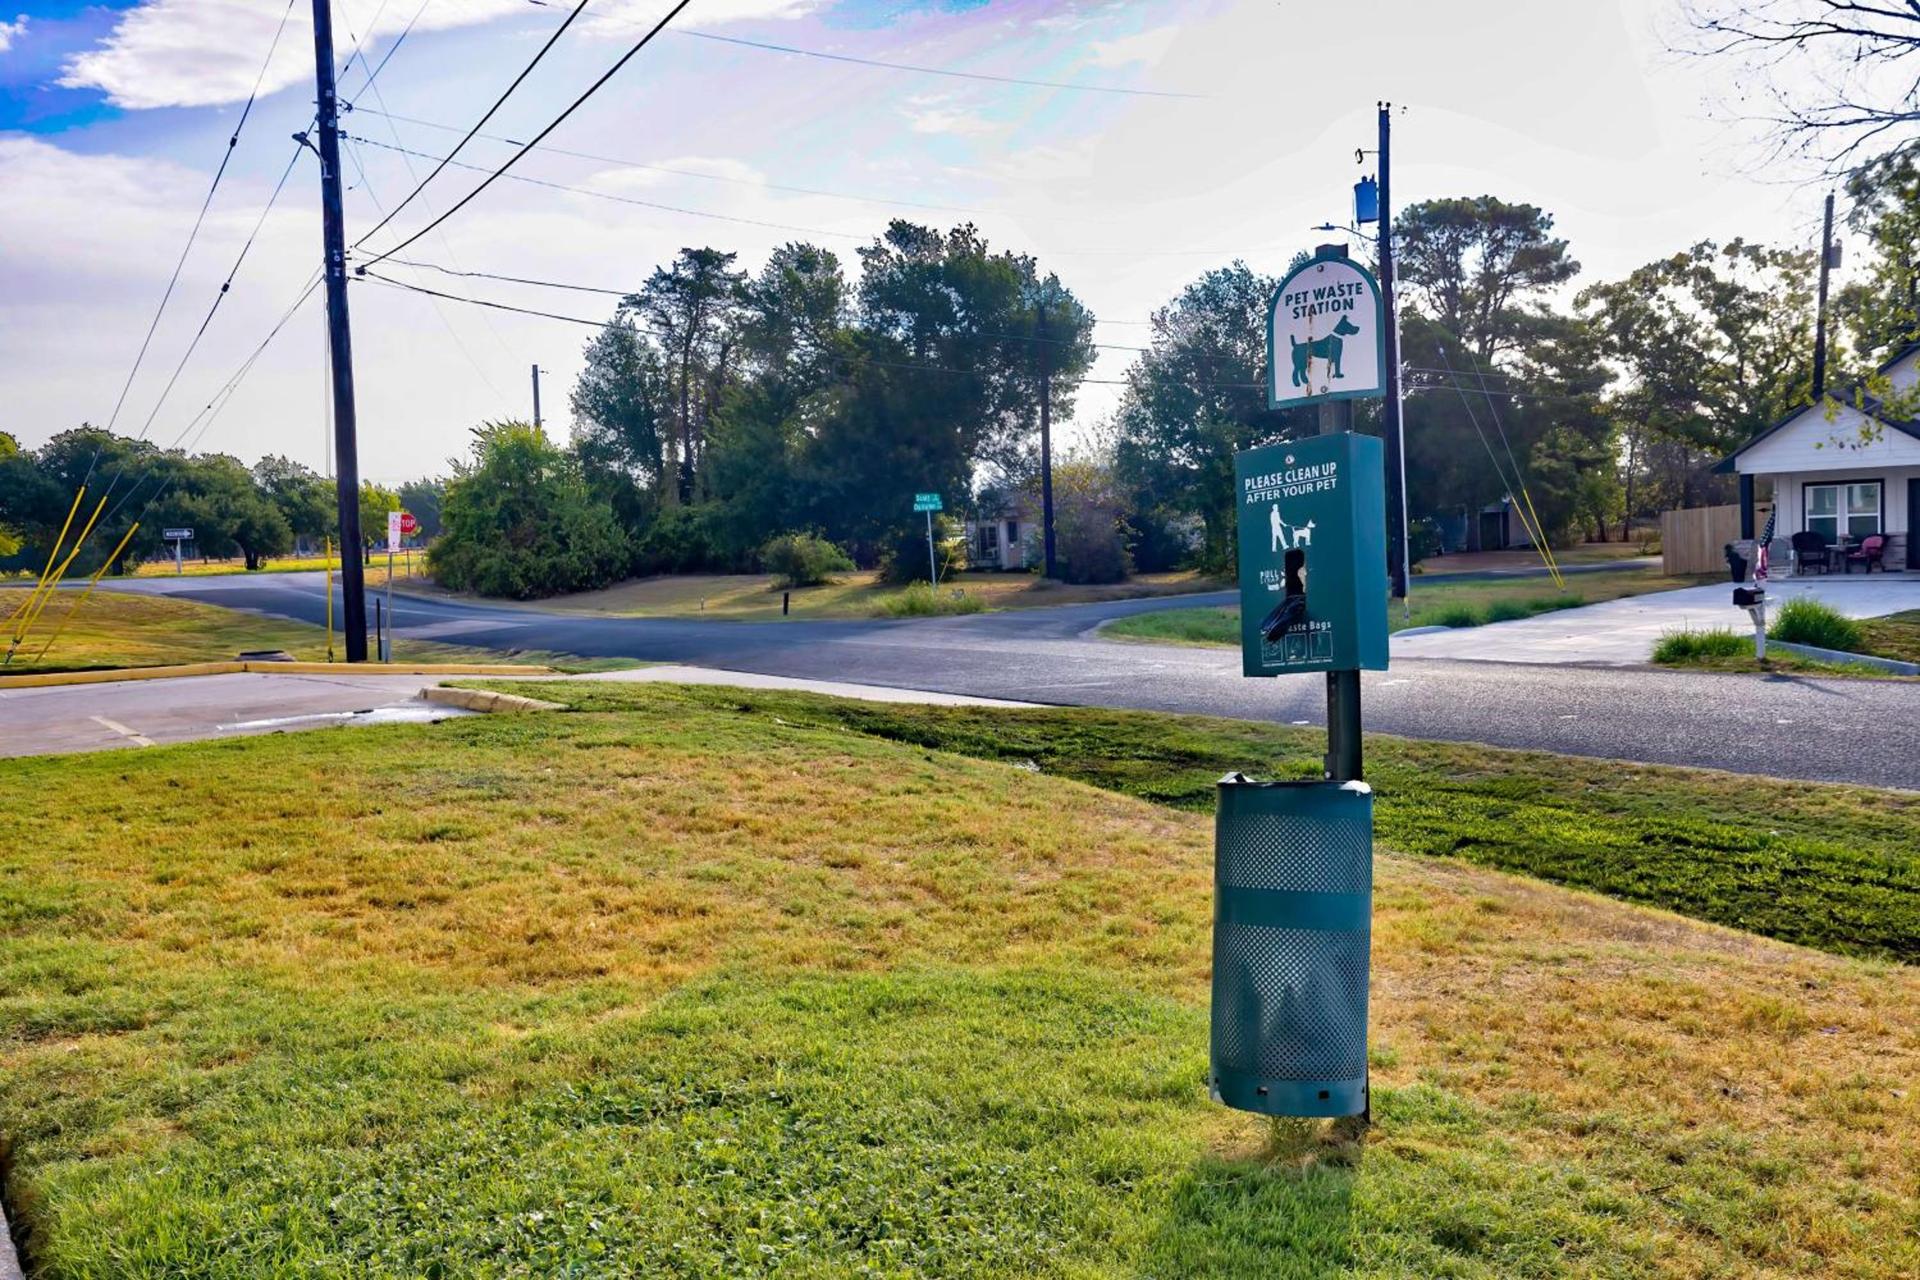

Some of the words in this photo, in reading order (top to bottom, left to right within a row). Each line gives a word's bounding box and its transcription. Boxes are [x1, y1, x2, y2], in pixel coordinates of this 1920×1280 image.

[1285, 290, 1309, 307] PET
[1312, 282, 1363, 301] WASTE
[1292, 298, 1354, 319] STATION
[1244, 472, 1283, 490] PLEASE
[1285, 465, 1319, 483] CLEAN
[1321, 462, 1337, 476] UP
[1246, 489, 1281, 504] AFTER
[1282, 483, 1314, 497] YOUR
[1316, 478, 1337, 491] PET
[401, 519, 416, 528] TOP
[1288, 623, 1307, 632] aste
[1309, 620, 1332, 631] Bags
